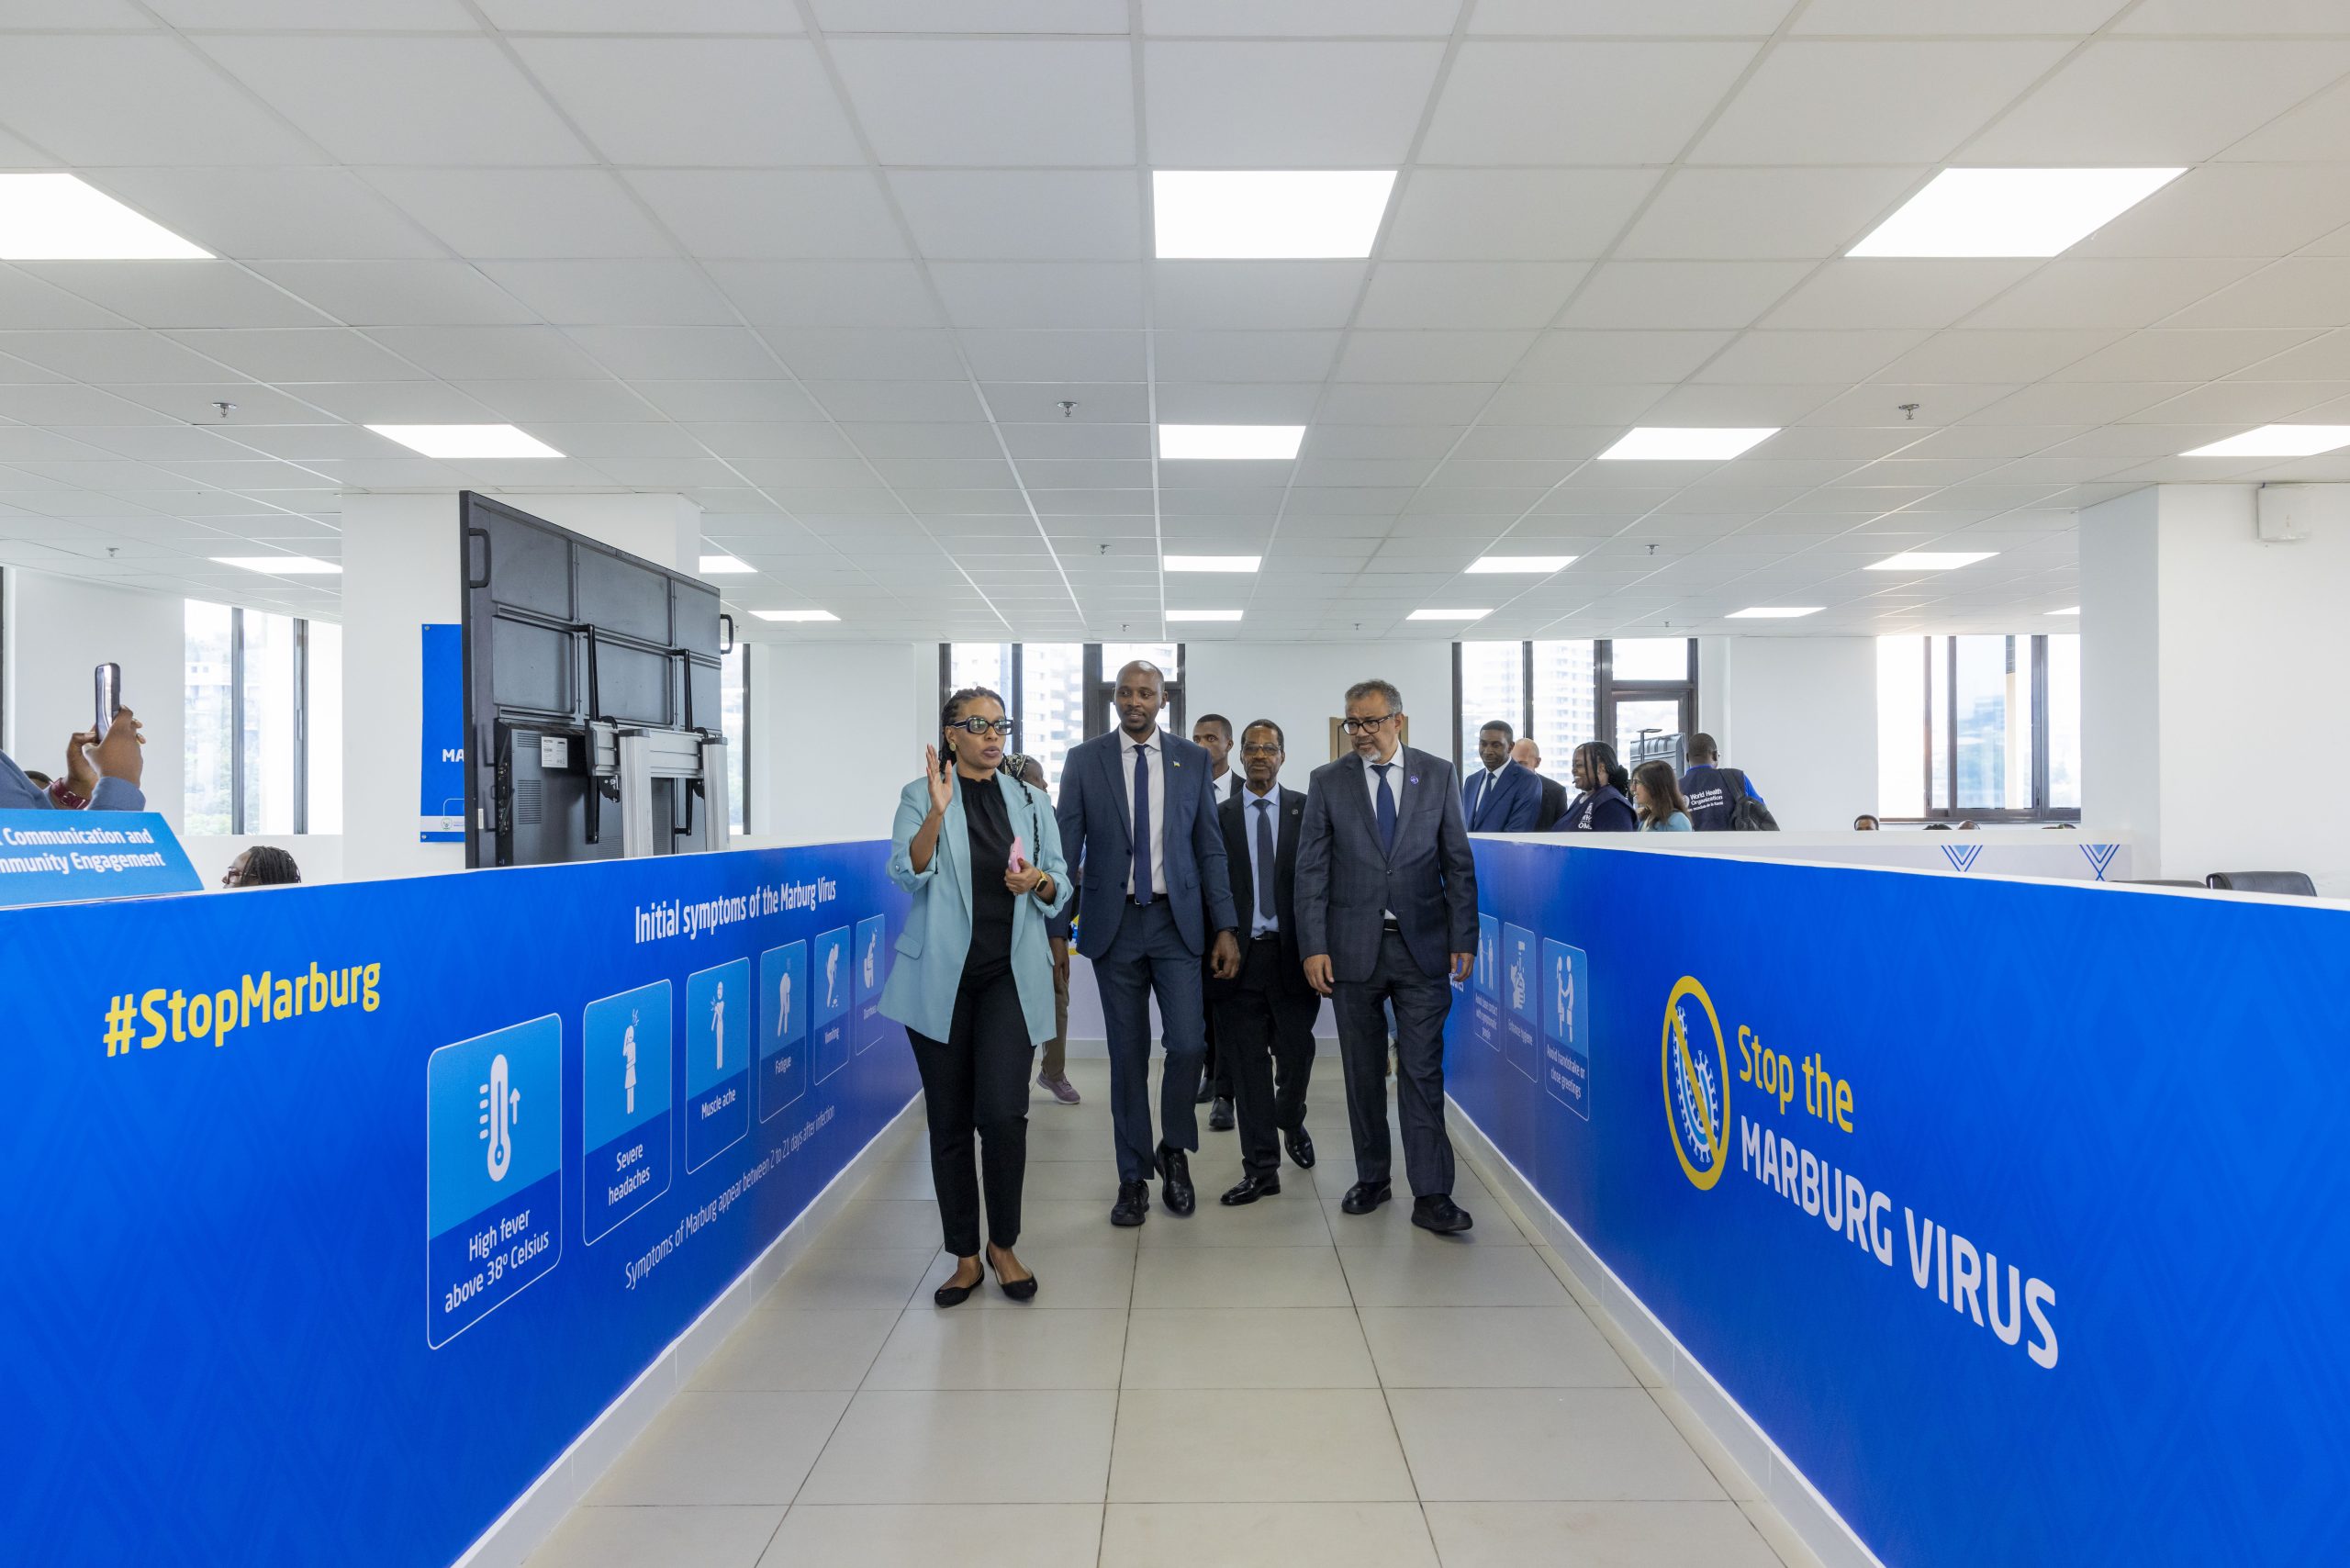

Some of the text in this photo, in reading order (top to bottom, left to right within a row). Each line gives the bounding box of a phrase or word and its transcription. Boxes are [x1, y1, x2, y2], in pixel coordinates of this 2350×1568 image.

[1689, 788, 1722, 800] World Health
[1690, 795, 1723, 806] Organization
[3, 827, 155, 846] Communication and
[70, 852, 166, 873] Engagement
[635, 876, 836, 944] Initial symptoms of the Marburg Virus
[103, 961, 382, 1058] #StopMarburg
[775, 1056, 792, 1075] Fatigue
[1738, 1024, 1853, 1134] Stop the
[701, 1088, 736, 1120] Muscle ache
[616, 1144, 643, 1172] Severe
[609, 1166, 651, 1206] headaches
[625, 1234, 674, 1290] Symptoms
[675, 1225, 684, 1248] of
[686, 1200, 717, 1239] Marburg
[719, 1179, 742, 1214] appear
[743, 1157, 769, 1193] between
[771, 1149, 775, 1170] 2
[776, 1148, 782, 1165] to
[782, 1137, 789, 1159] 21
[790, 1132, 803, 1152] days
[803, 1120, 815, 1142] after
[469, 1209, 531, 1261] High fever
[1740, 1114, 2059, 1370] MARBURG VIRUS
[444, 1272, 484, 1314] above
[510, 1230, 549, 1269] Celsius
